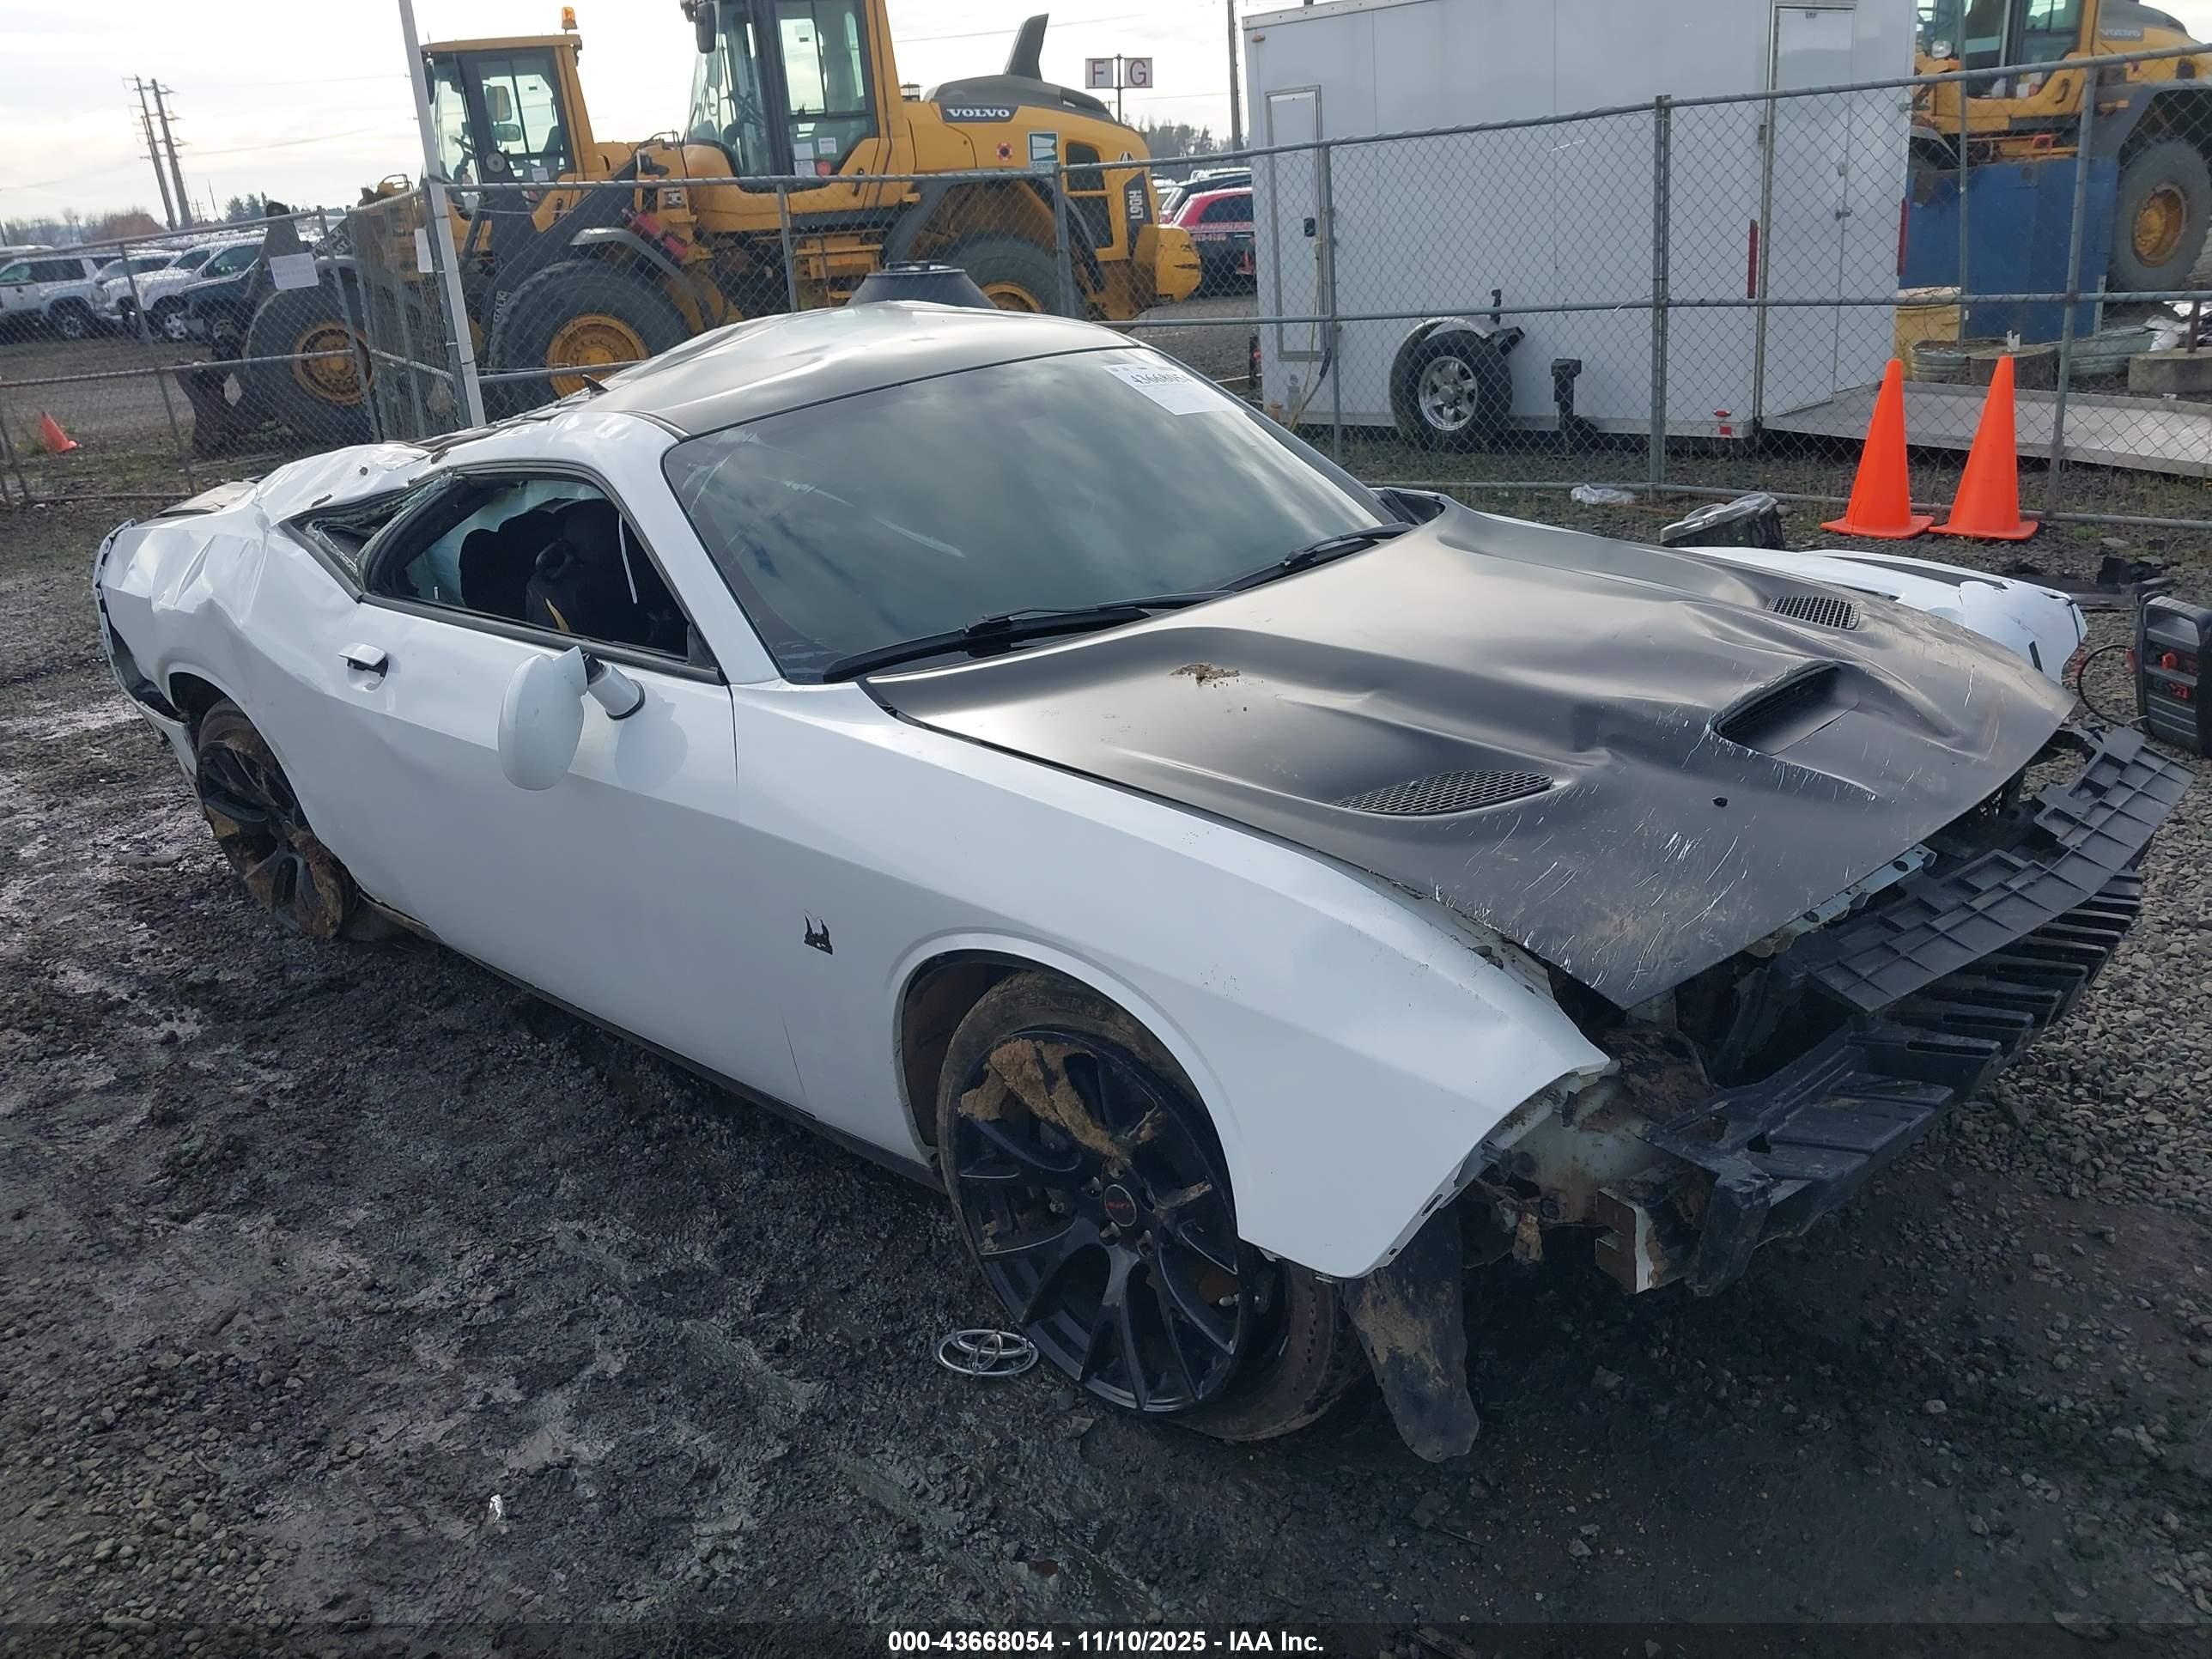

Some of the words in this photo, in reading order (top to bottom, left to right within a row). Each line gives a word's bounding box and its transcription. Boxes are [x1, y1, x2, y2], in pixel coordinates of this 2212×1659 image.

[1091, 60, 1105, 87] F
[1129, 59, 1147, 86] G
[945, 107, 1011, 118] VOLVO
[1127, 189, 1144, 220] L90H
